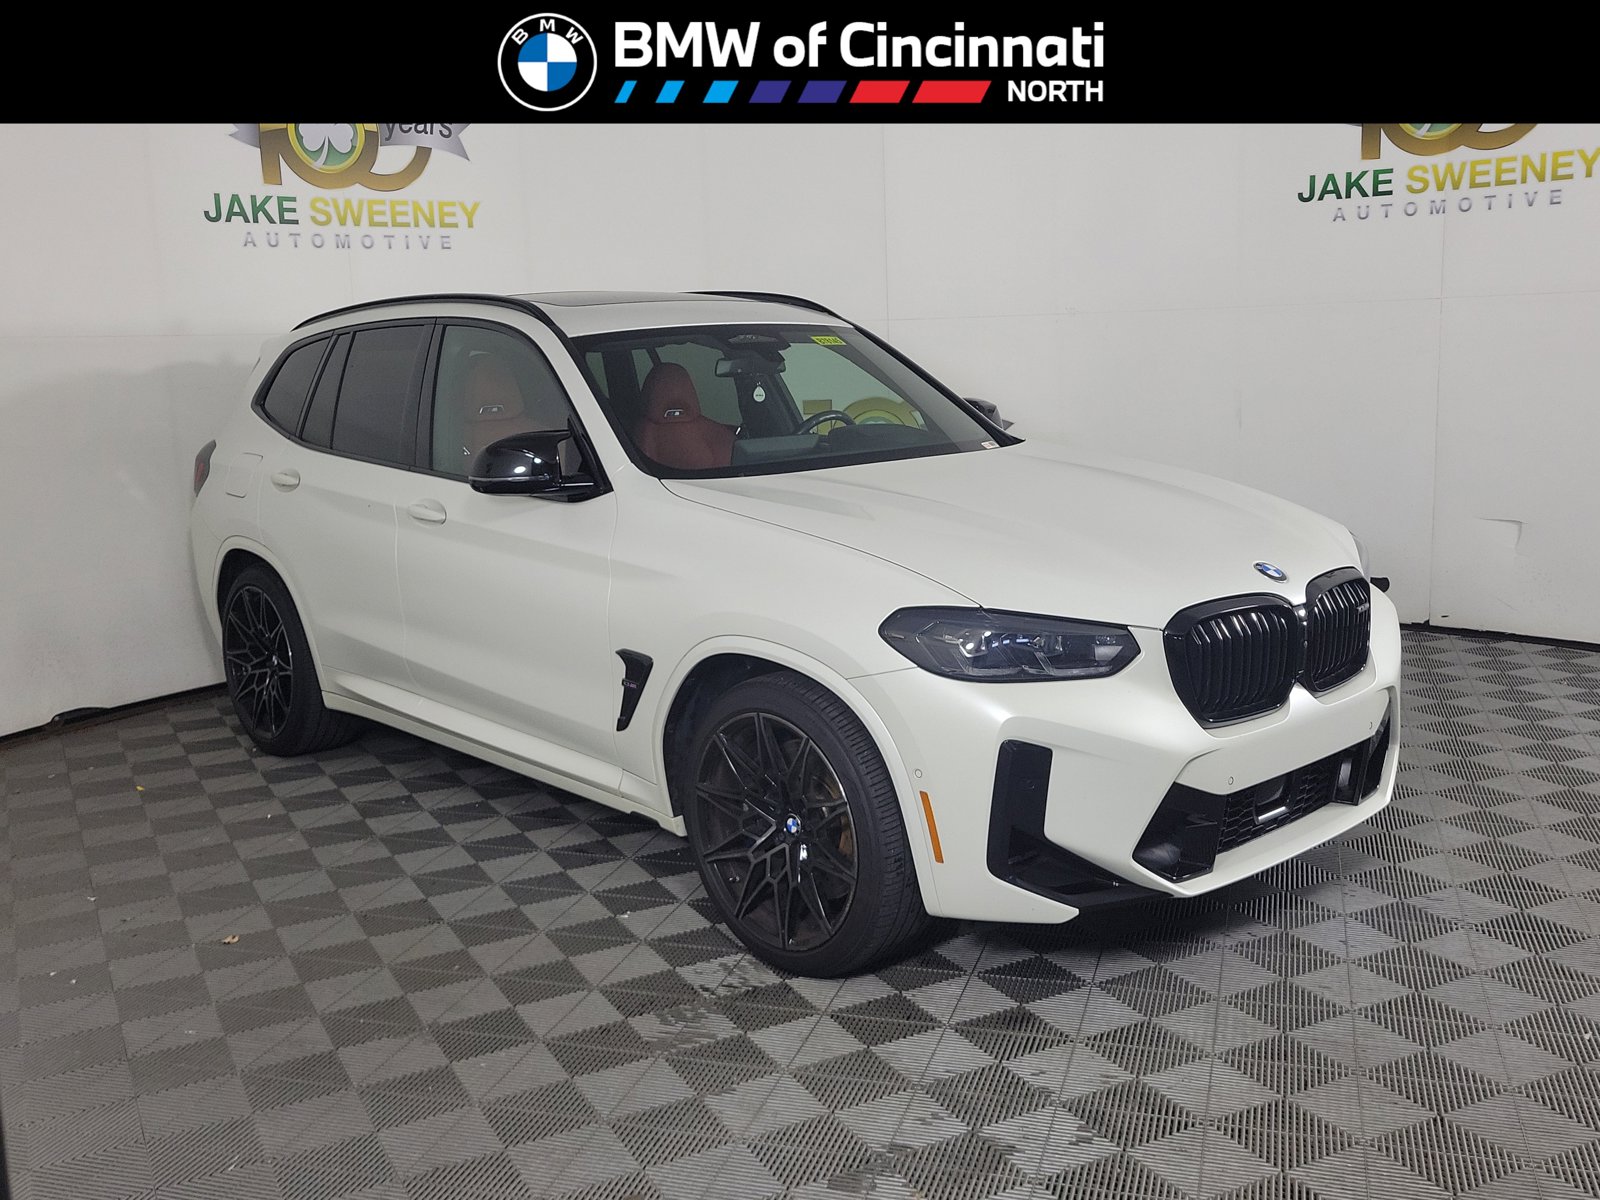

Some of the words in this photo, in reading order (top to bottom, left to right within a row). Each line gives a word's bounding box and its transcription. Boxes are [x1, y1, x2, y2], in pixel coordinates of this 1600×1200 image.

[1297, 167, 1395, 203] JAKE
[1404, 146, 1600, 195] SWEENEY
[203, 192, 300, 225] JAKE
[309, 196, 481, 228] SWEENEY
[1332, 189, 1563, 222] AUTOMOTIVE
[243, 232, 452, 250] AUTOMOTIVE
